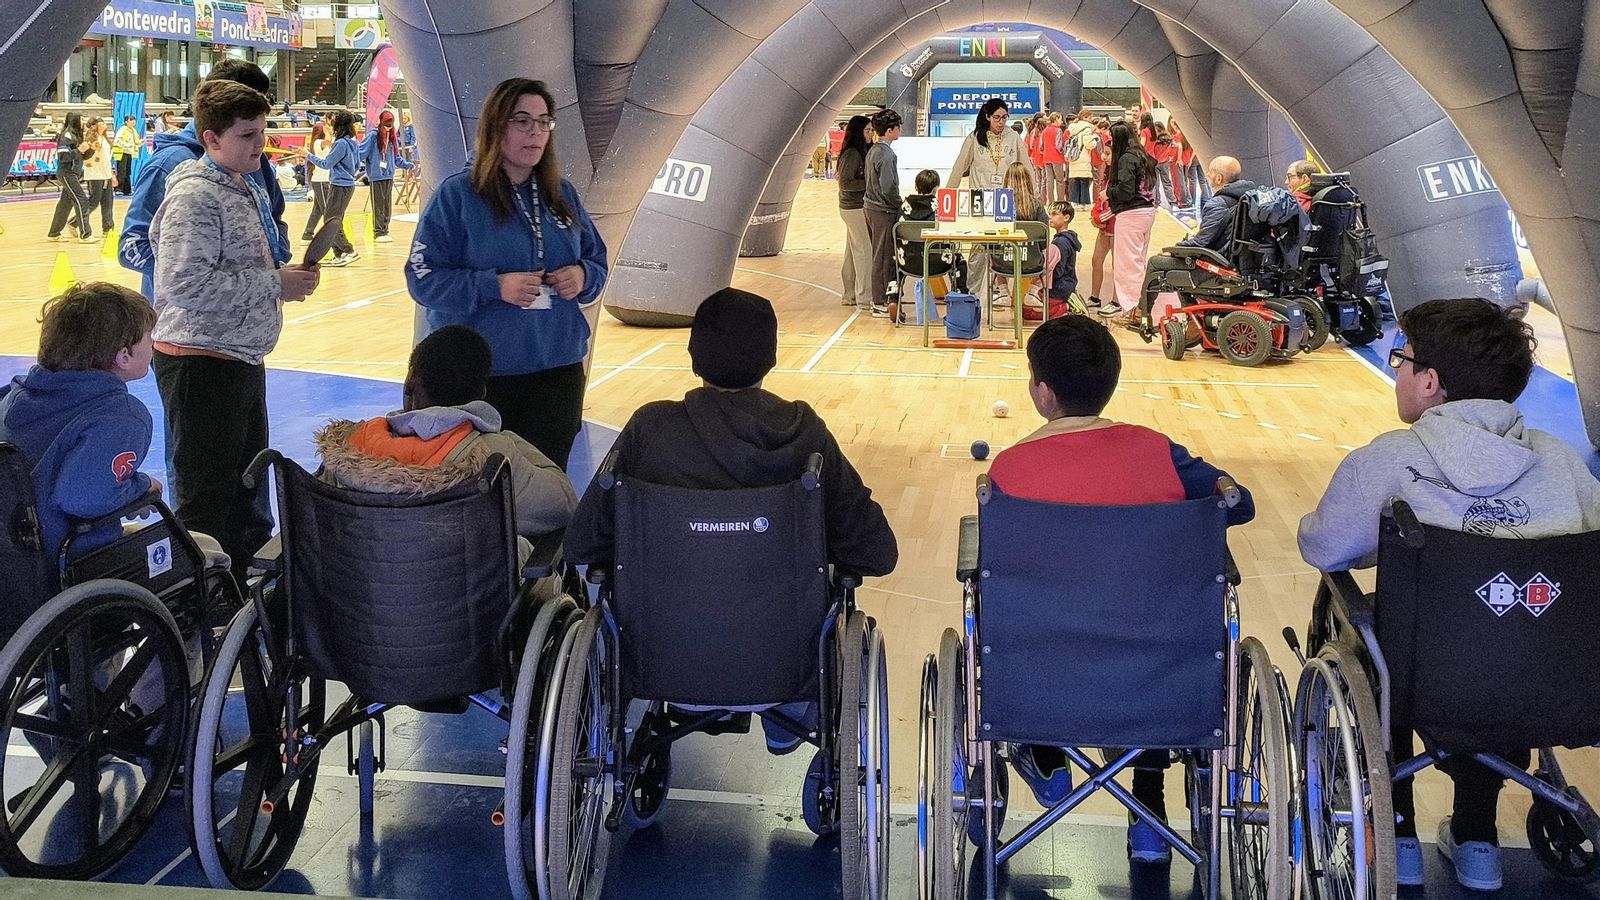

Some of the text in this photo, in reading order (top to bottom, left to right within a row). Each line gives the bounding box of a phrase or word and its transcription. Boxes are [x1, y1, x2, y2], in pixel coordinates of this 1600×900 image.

[103, 5, 191, 35] Pontevedra
[221, 18, 289, 44] Pontedra
[959, 36, 1006, 58] ENKI
[952, 93, 1017, 101] DEPORTE
[1424, 159, 1498, 199] ENK
[943, 194, 952, 214] 0
[973, 195, 981, 213] 5
[1000, 194, 1008, 213] 0
[689, 521, 750, 532] VERMEIREN
